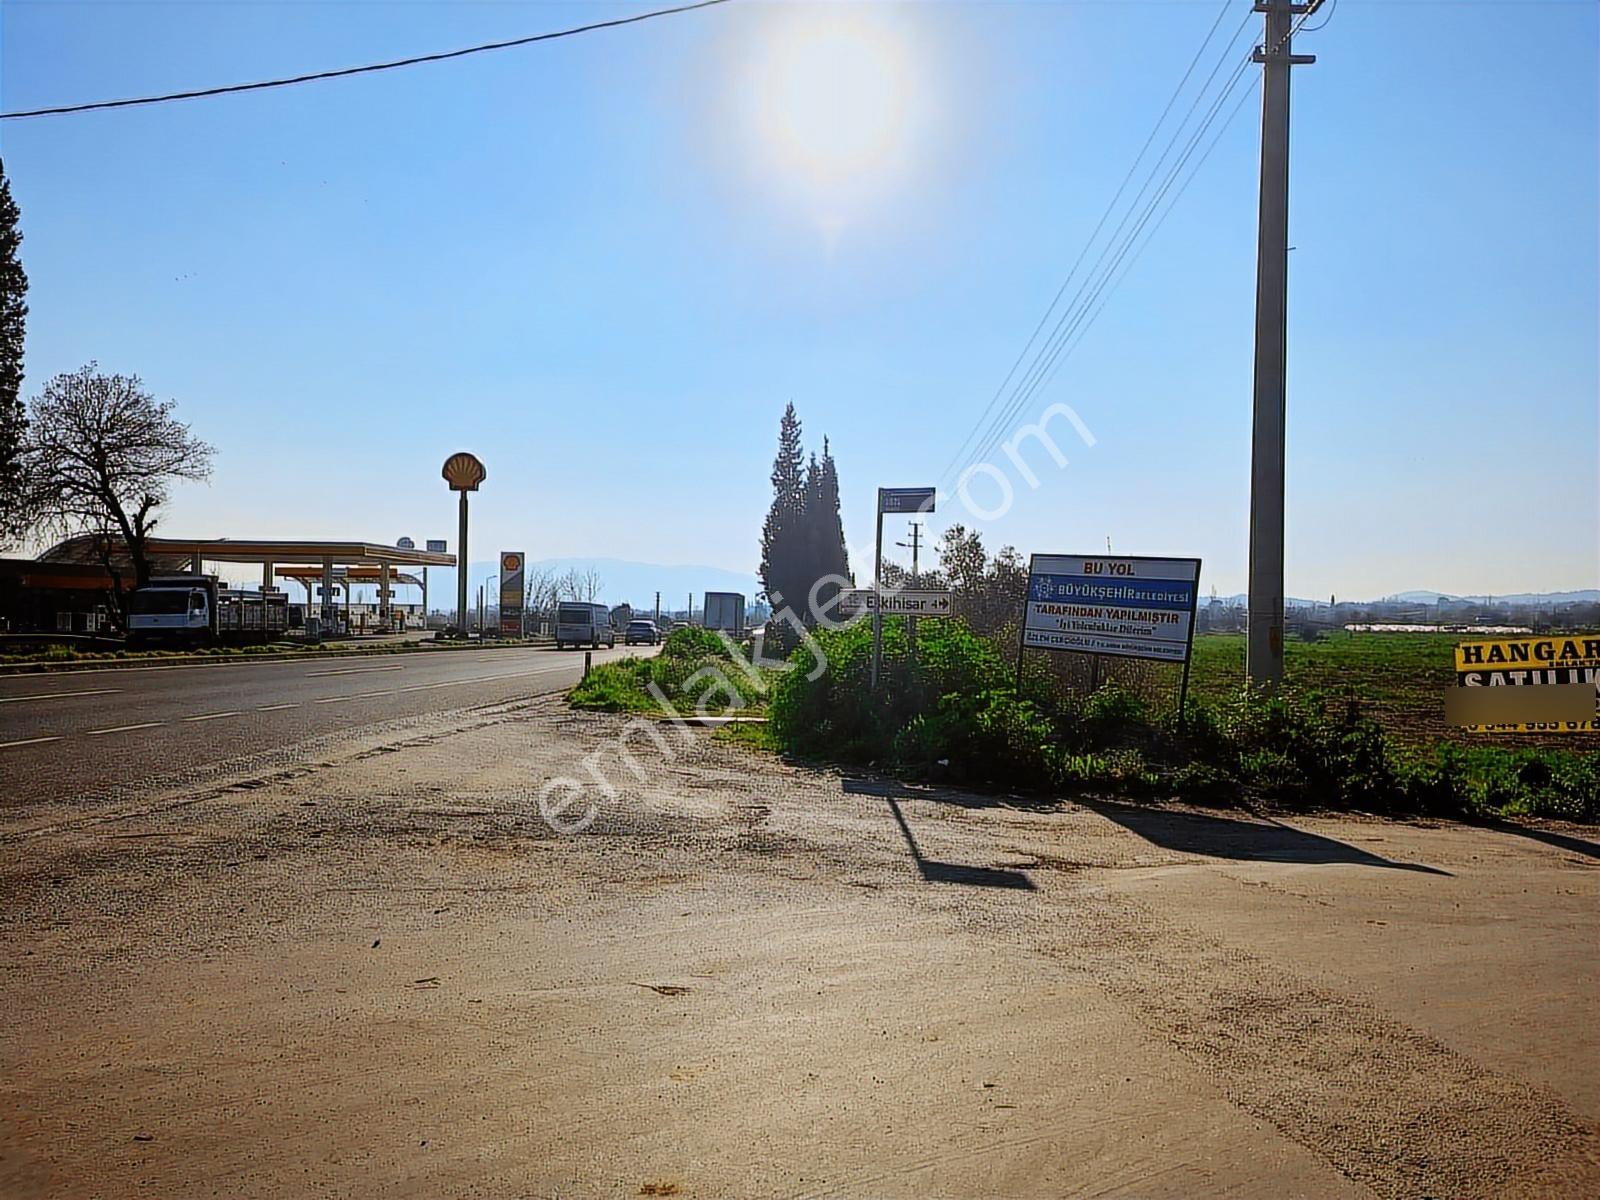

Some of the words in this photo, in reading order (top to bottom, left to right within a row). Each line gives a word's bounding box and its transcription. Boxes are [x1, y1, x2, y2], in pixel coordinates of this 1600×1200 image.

[1084, 562, 1103, 574] BU
[1108, 563, 1135, 576] YOL
[1058, 583, 1135, 599] BÜYÜKŞEHİR
[866, 596, 927, 610] Ekihisar
[1035, 604, 1103, 618] TARAFINDAN
[1106, 610, 1180, 625] YAPILMIŞTIR
[1462, 640, 1600, 664] HANGAR
